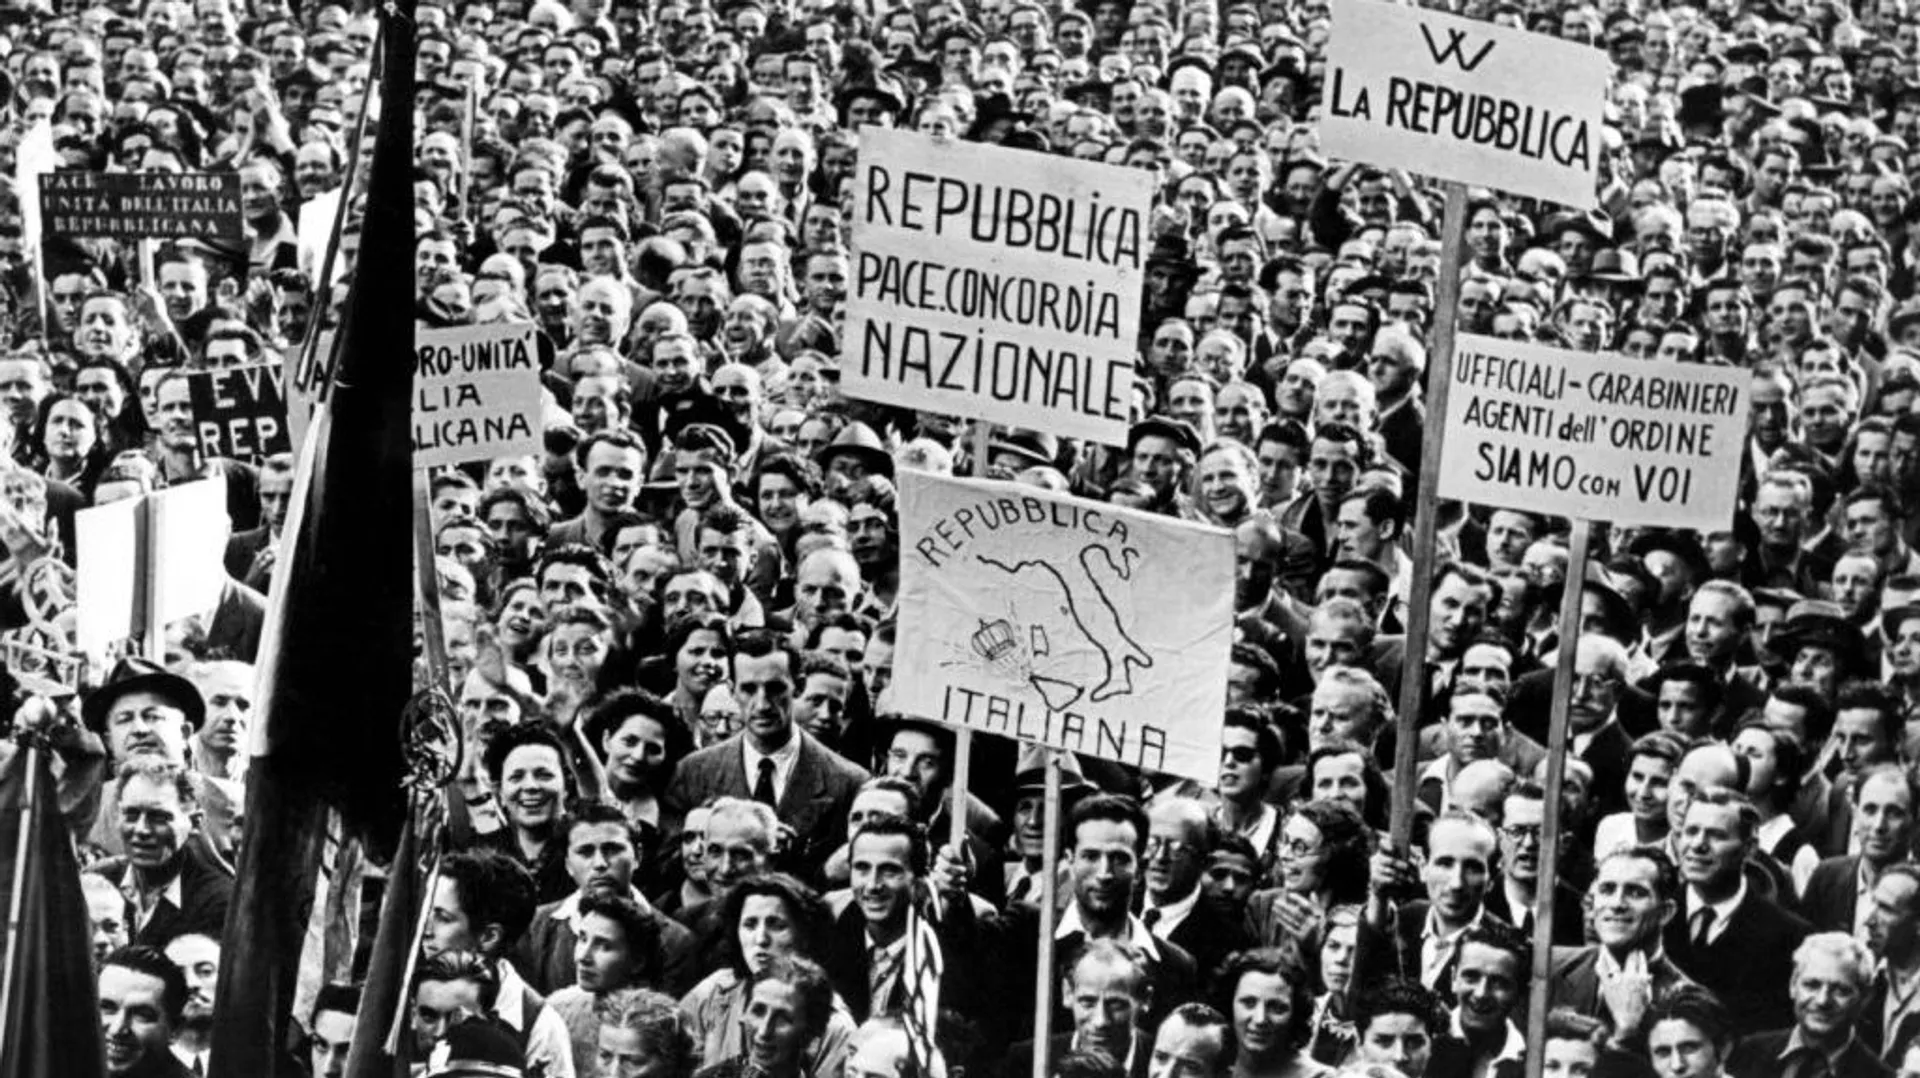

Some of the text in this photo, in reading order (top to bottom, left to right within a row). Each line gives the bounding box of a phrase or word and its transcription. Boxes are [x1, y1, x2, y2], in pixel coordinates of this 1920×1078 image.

[1331, 67, 1590, 172] LA REPUBBLICA
[139, 176, 223, 190] LAVORO
[54, 216, 218, 235] REPUBBLICANA
[1463, 396, 1554, 439] AGENTI
[1475, 442, 1576, 490] SIAMO
[1634, 465, 1692, 505] VOI
[915, 497, 1129, 567] REPUBBLICA
[942, 685, 1166, 770] ITALIANA
